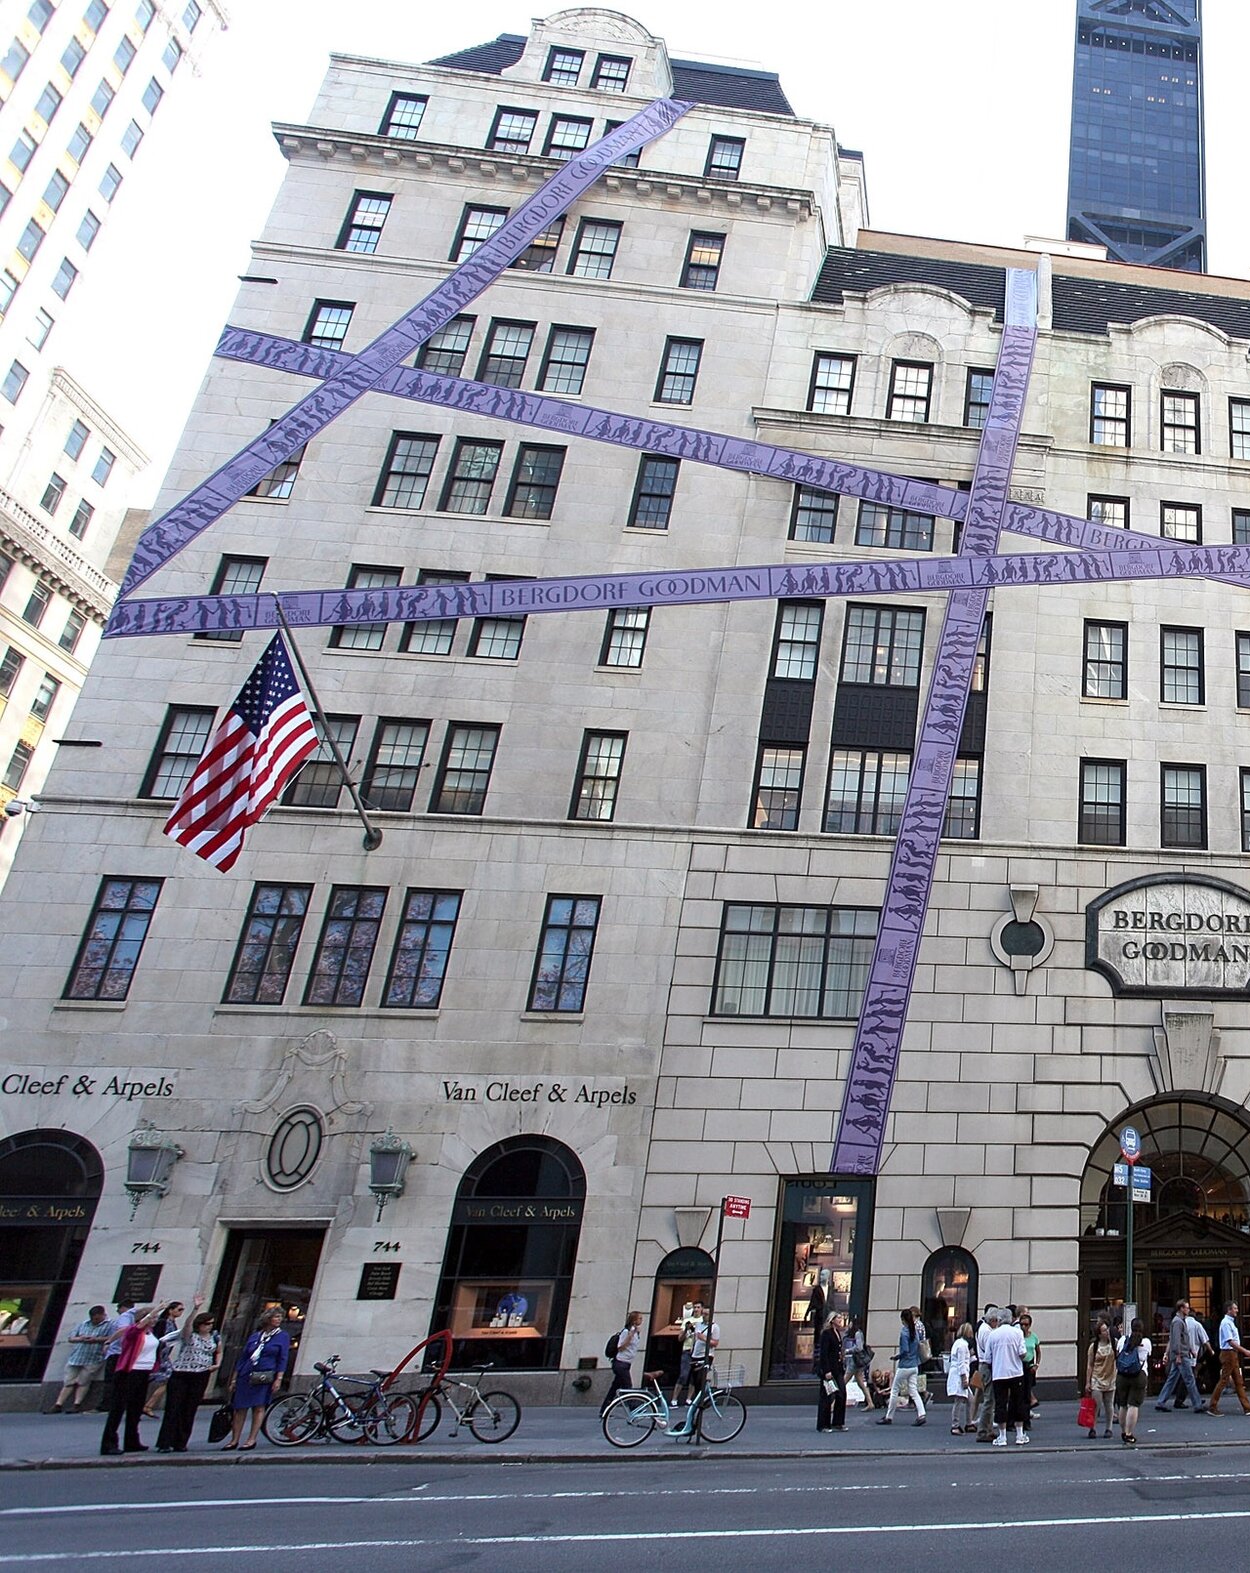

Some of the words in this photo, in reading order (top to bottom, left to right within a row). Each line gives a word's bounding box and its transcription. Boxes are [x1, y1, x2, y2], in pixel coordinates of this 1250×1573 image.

[497, 178, 574, 250] BERGDORF
[1090, 528, 1167, 549] BERG
[501, 581, 629, 606] BERGDORF
[638, 574, 762, 597] GOODMAN
[1122, 941, 1250, 963] GOODMAN
[1, 1074, 69, 1096] Cleef
[72, 1074, 97, 1096] &
[102, 1076, 174, 1101] Arpels
[442, 1081, 477, 1101] Van
[486, 1081, 544, 1102] Cleef
[547, 1084, 568, 1103] &
[574, 1084, 637, 1108] Arpels
[27, 1205, 41, 1218] &
[45, 1205, 86, 1221] Arpels
[465, 1206, 486, 1217] Van
[490, 1206, 521, 1218] Cleef
[524, 1206, 535, 1218] &
[541, 1206, 576, 1221] Arpels
[131, 1242, 161, 1254] 744
[373, 1241, 401, 1252] 744
